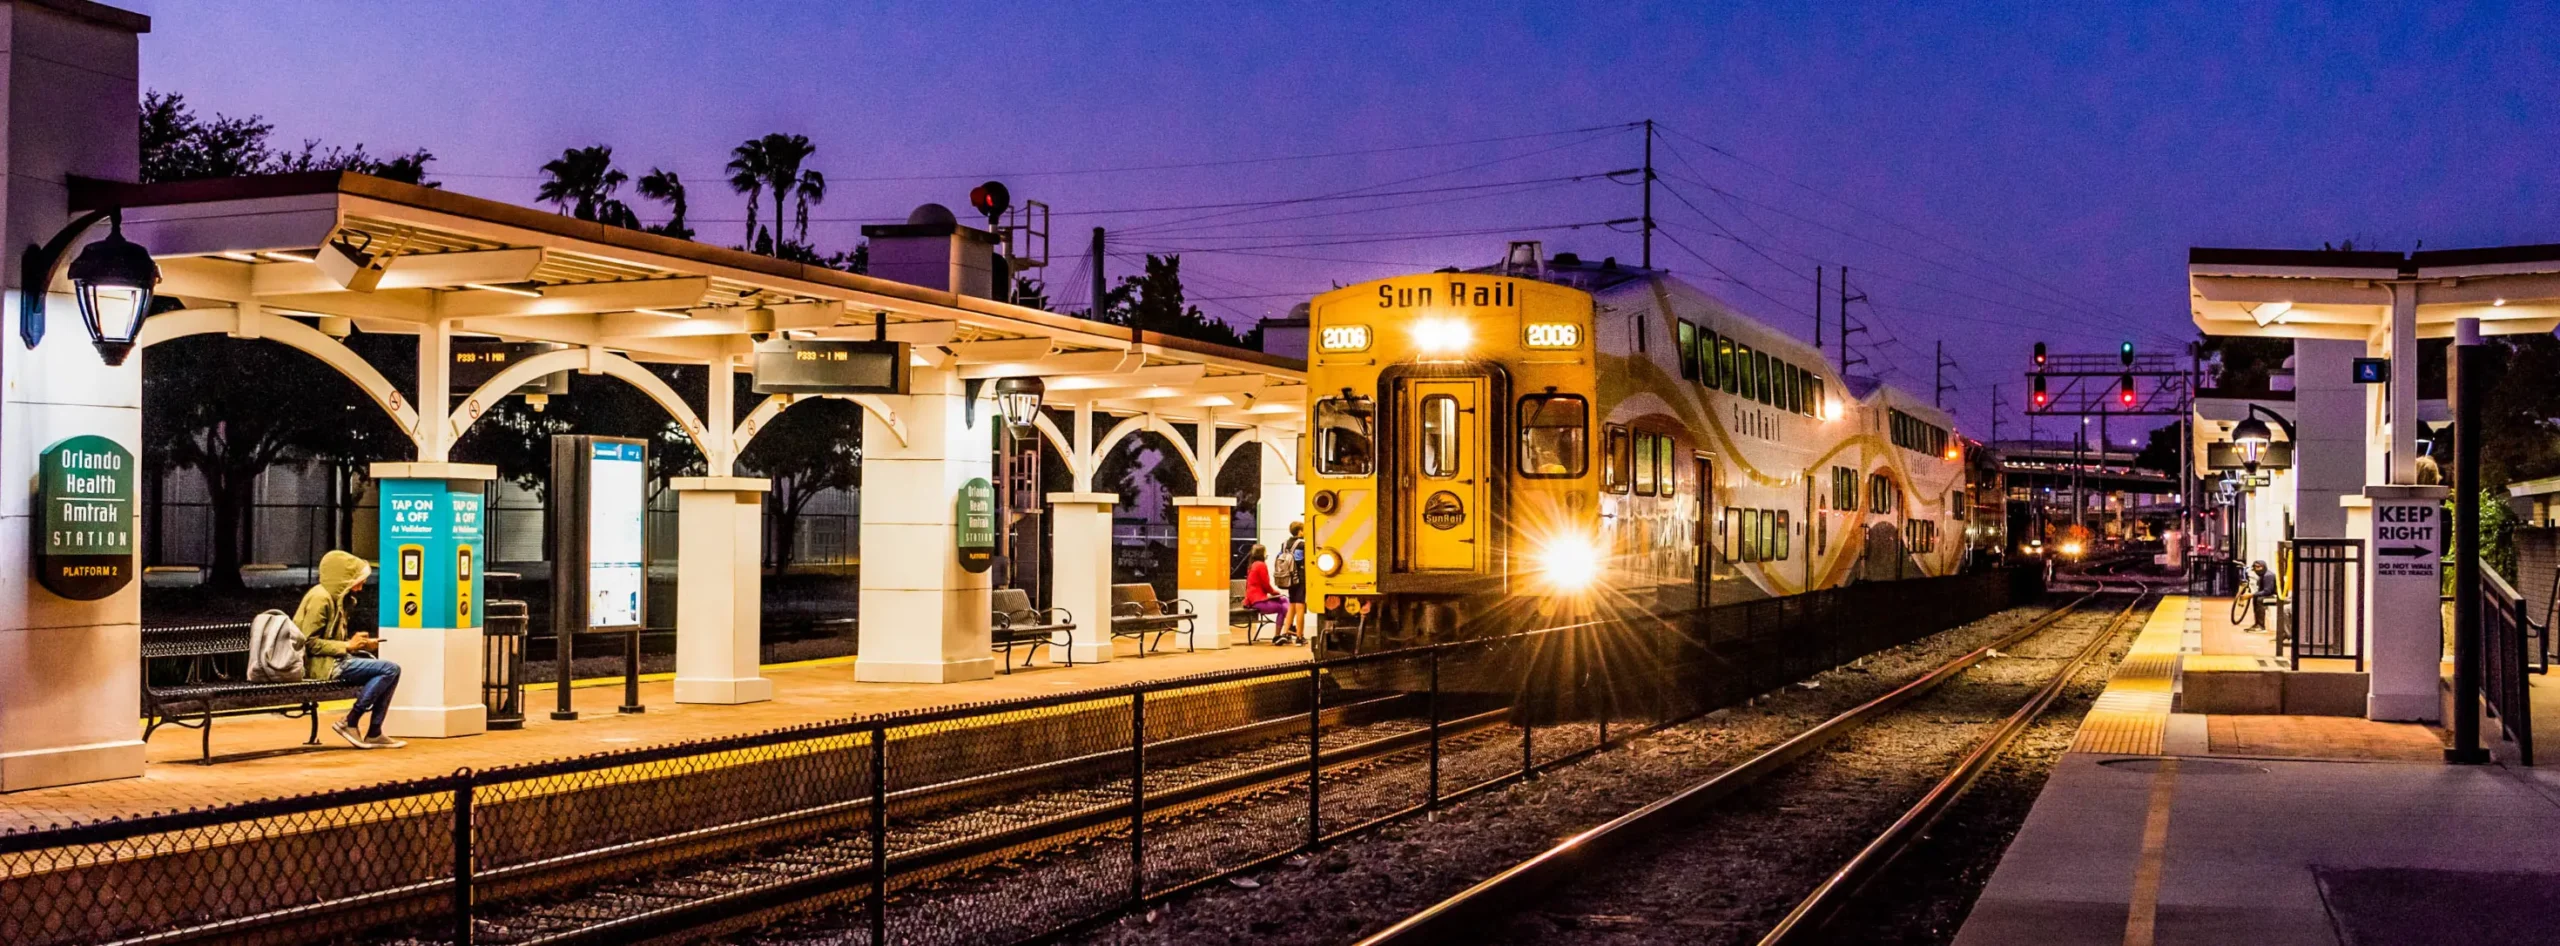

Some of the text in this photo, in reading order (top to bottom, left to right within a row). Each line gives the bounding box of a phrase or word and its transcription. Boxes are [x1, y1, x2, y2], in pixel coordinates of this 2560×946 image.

[1378, 282, 1514, 309] Sun Rail
[1323, 327, 1366, 349] 2006
[1528, 324, 1576, 347] 2006
[1734, 402, 1780, 441] SunRail
[62, 449, 121, 470] Orlando
[66, 474, 116, 494] Health
[967, 485, 990, 498] Orlando
[63, 502, 118, 522] Amtrak
[391, 500, 433, 511] TAP ON
[452, 501, 478, 511] TAP ON
[969, 500, 988, 512] Health
[395, 512, 429, 522] & OFF
[455, 513, 476, 523] & OFF
[1426, 514, 1462, 523] SunRail
[2379, 506, 2433, 522] KEEP
[391, 525, 432, 533] At Validator
[2379, 526, 2433, 540] RIGHT
[53, 531, 127, 546] STATION
[966, 533, 993, 542] STATION
[63, 566, 117, 577] PLATFORM 2
